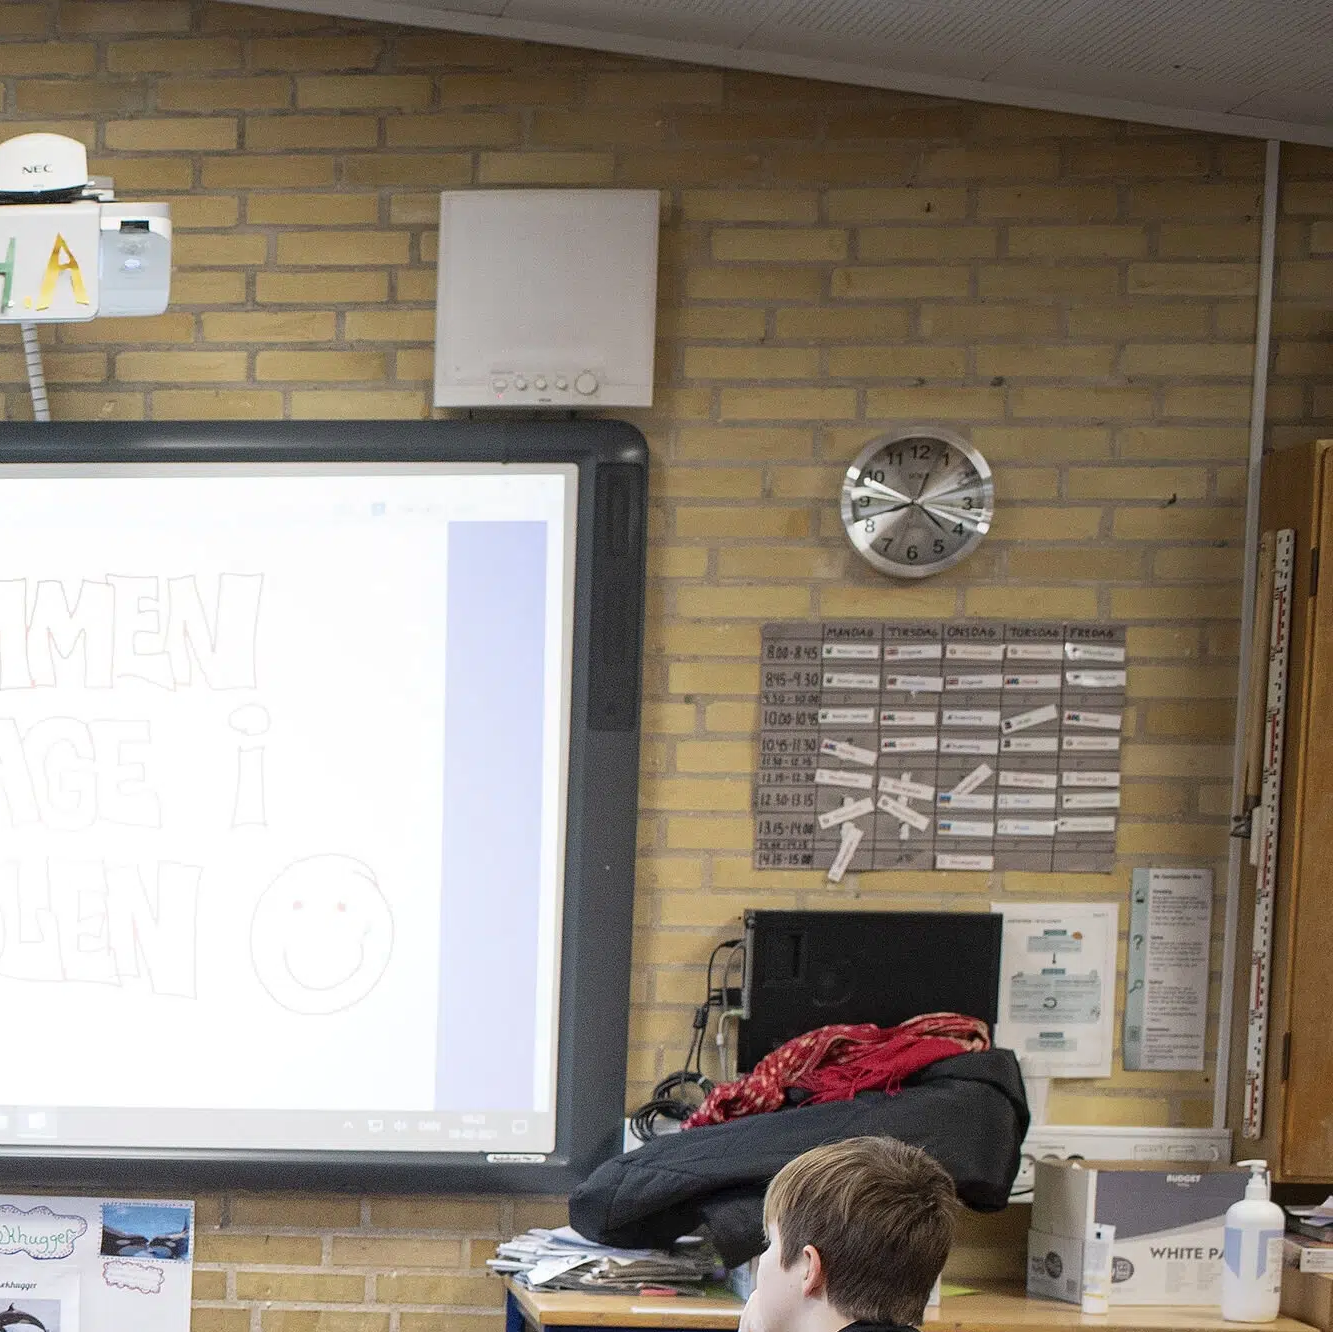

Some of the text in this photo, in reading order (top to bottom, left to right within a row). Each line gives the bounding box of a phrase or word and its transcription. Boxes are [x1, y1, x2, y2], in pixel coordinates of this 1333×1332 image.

[21, 164, 54, 174] NEC
[887, 451, 904, 466] 11
[910, 445, 931, 460] 12
[943, 452, 950, 466] 1
[962, 496, 972, 511] 3
[864, 519, 875, 533] 8
[952, 522, 963, 536] 4
[883, 538, 893, 552] 7
[933, 539, 945, 554] 5
[906, 545, 918, 560] 6
[1150, 1247, 1203, 1260] WHITE
